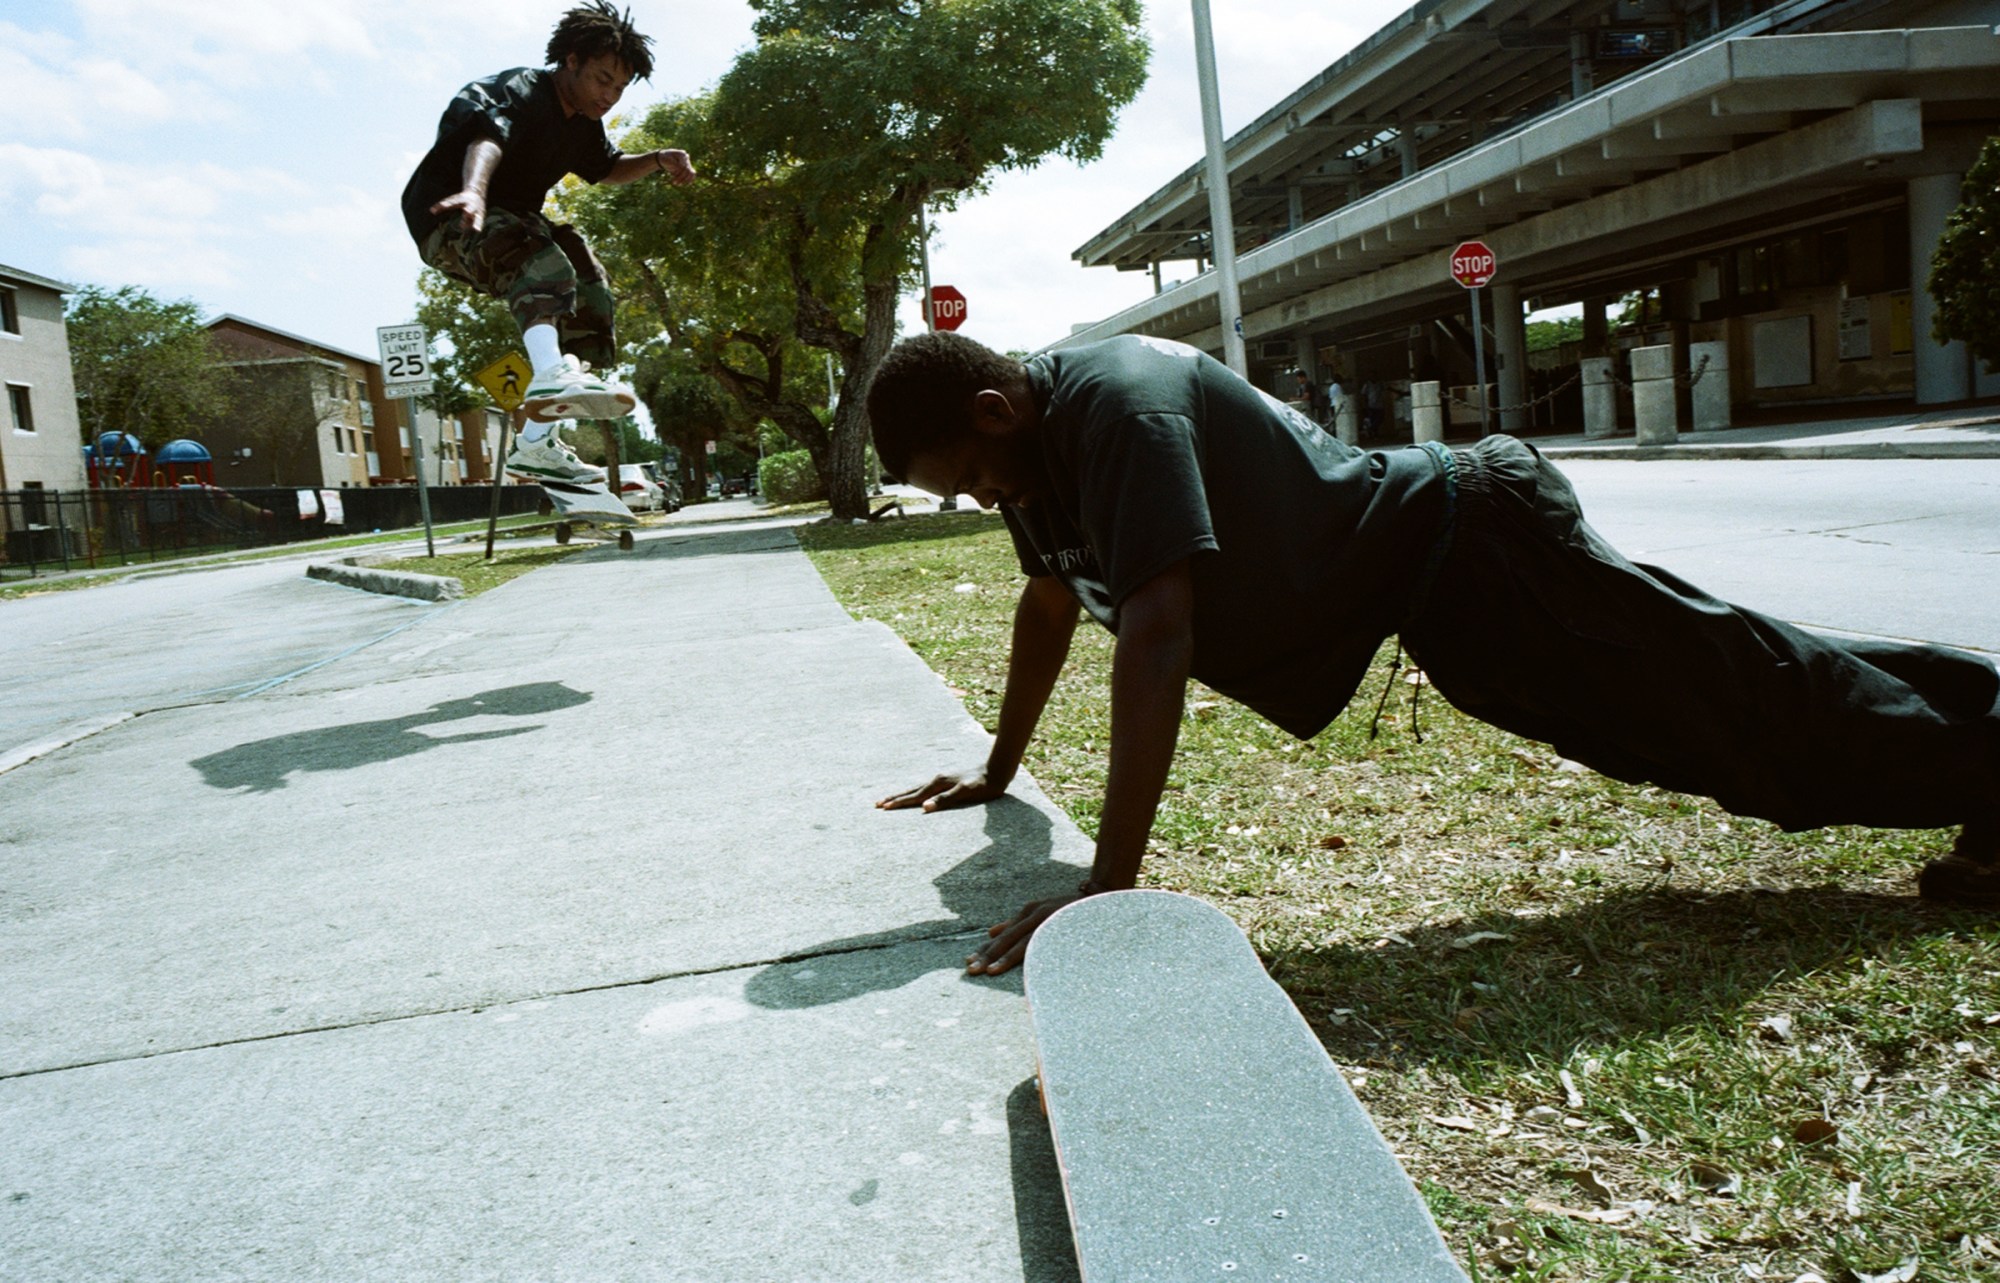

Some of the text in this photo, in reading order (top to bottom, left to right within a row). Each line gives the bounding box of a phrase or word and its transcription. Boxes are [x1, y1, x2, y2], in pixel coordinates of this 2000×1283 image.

[1454, 255, 1492, 274] STOP
[933, 299, 965, 318] TOP
[382, 331, 422, 342] SPEED
[387, 343, 418, 354] LIMIT
[387, 355, 424, 377] 25
